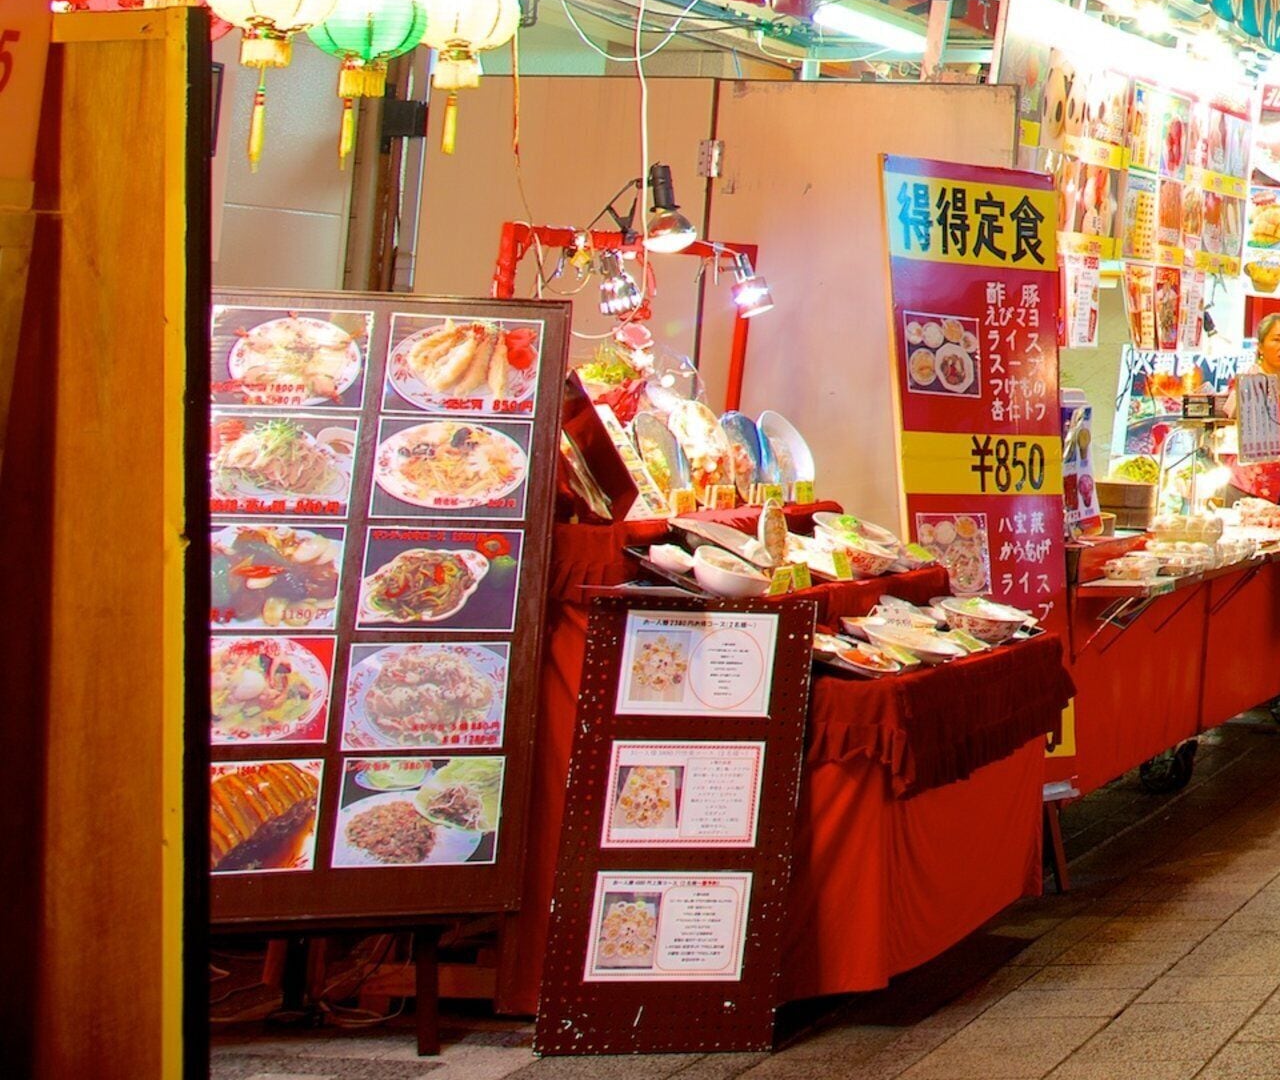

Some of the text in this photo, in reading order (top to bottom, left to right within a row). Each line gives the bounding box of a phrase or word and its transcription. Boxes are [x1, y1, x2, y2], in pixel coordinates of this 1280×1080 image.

[898, 180, 1047, 265] 得得定食
[985, 306, 1040, 328] えびマヨ
[987, 329, 1042, 353] ライス
[970, 434, 1046, 494] ¥850
[998, 511, 1045, 535] 八宝菜
[1001, 572, 1051, 596] ライス
[281, 607, 329, 620] 1180円
